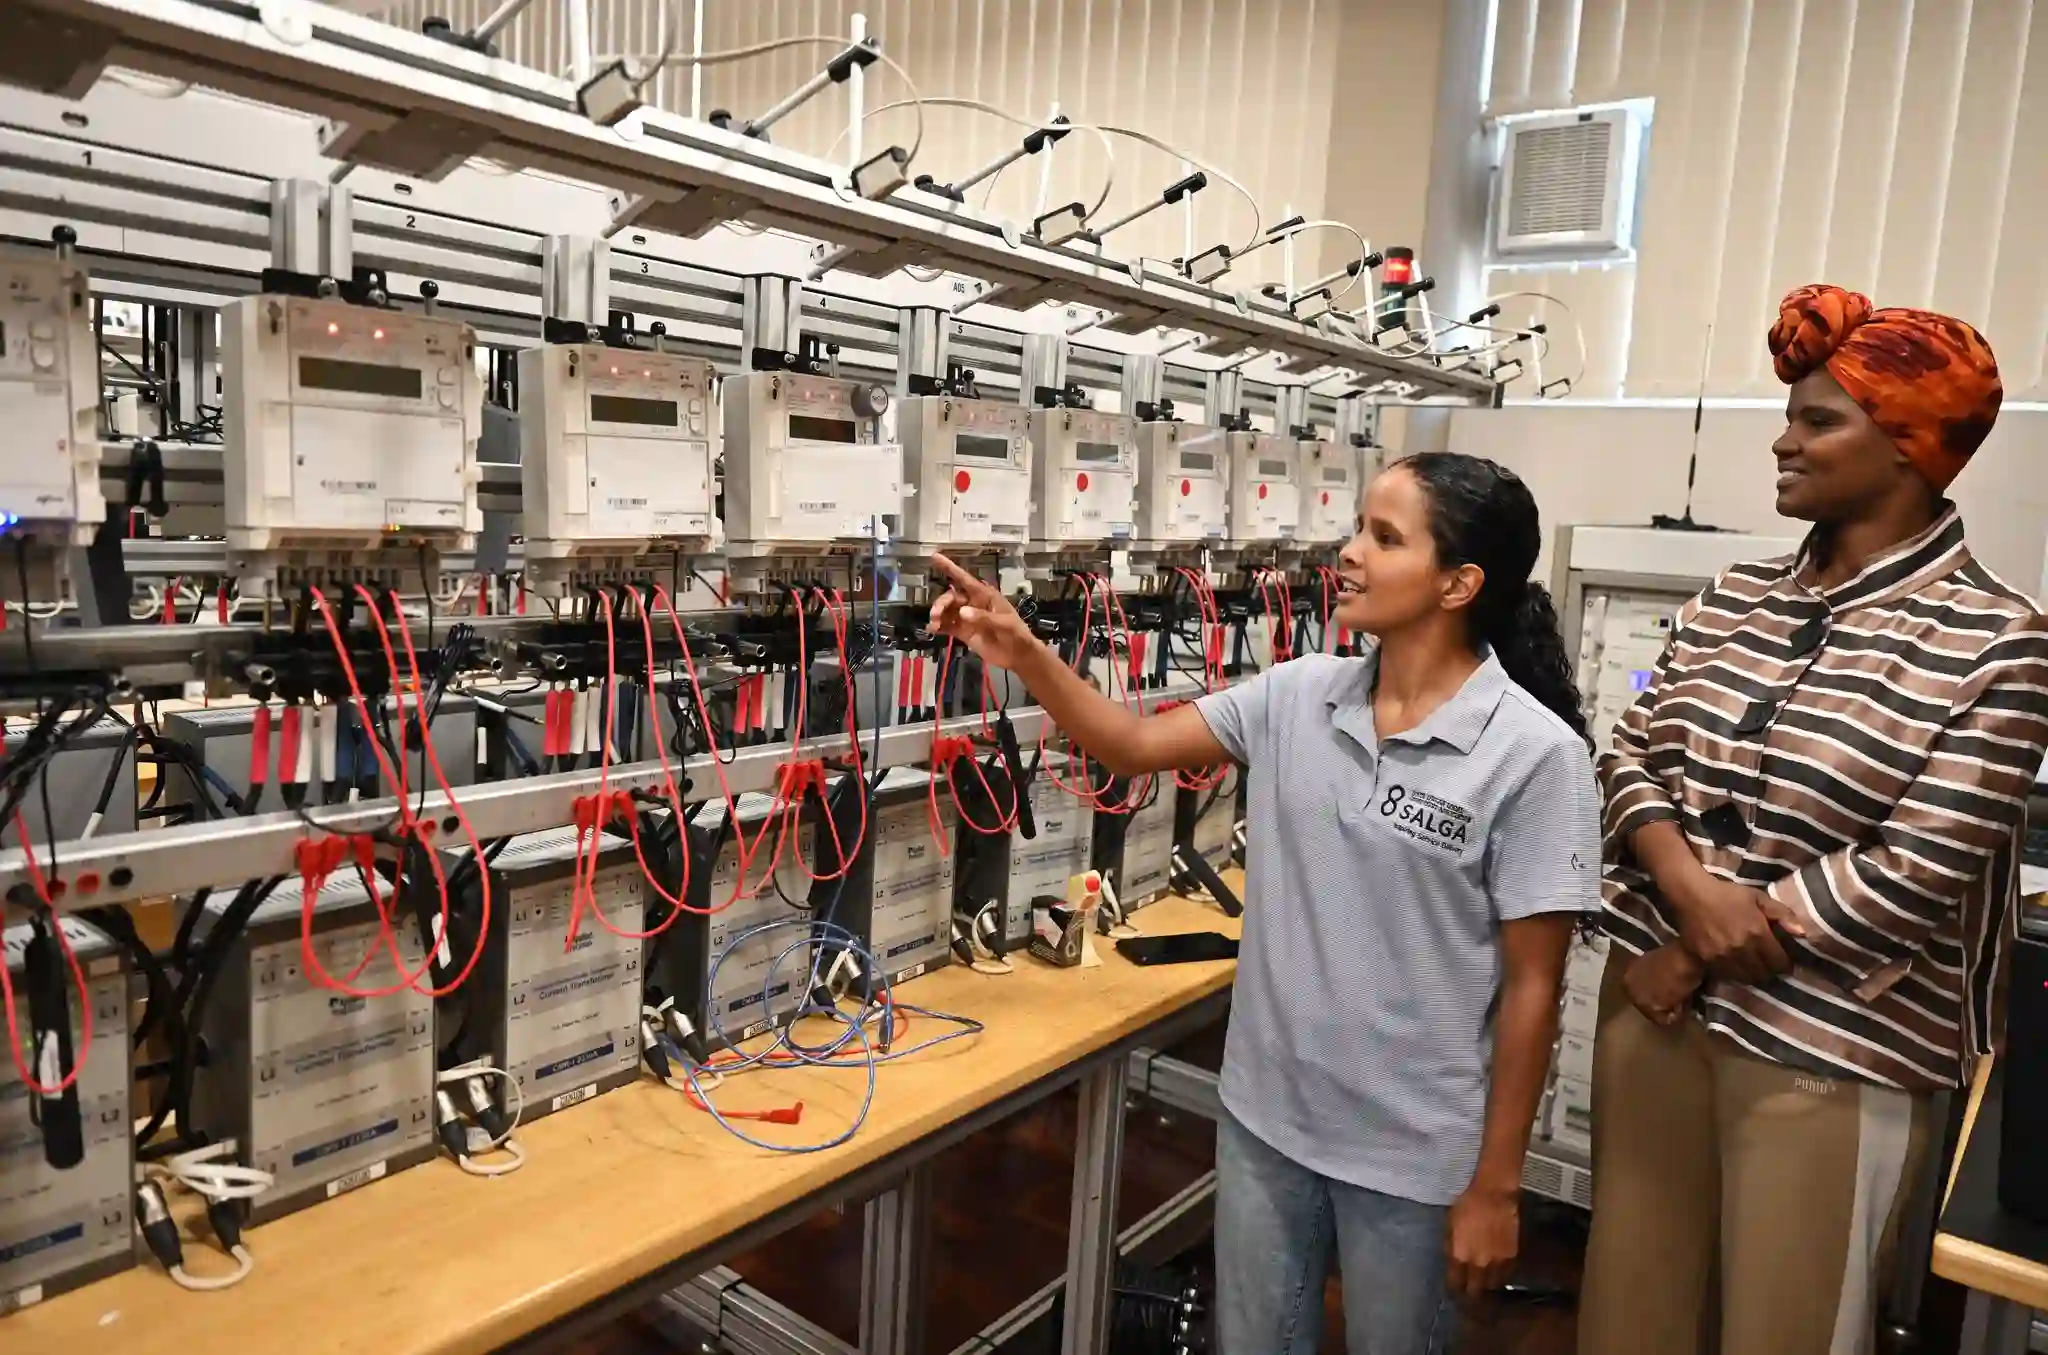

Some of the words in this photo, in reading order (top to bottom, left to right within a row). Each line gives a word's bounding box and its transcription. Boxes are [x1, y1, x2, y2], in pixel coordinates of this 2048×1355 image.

[82, 150, 92, 166] 1
[406, 214, 416, 229] 2
[640, 262, 649, 274] 3
[819, 297, 826, 308] 4
[957, 325, 964, 334] 5
[1399, 803, 1467, 844] SALGA
[626, 960, 638, 973] L2
[512, 992, 527, 1006] L2
[624, 1036, 636, 1049] L3
